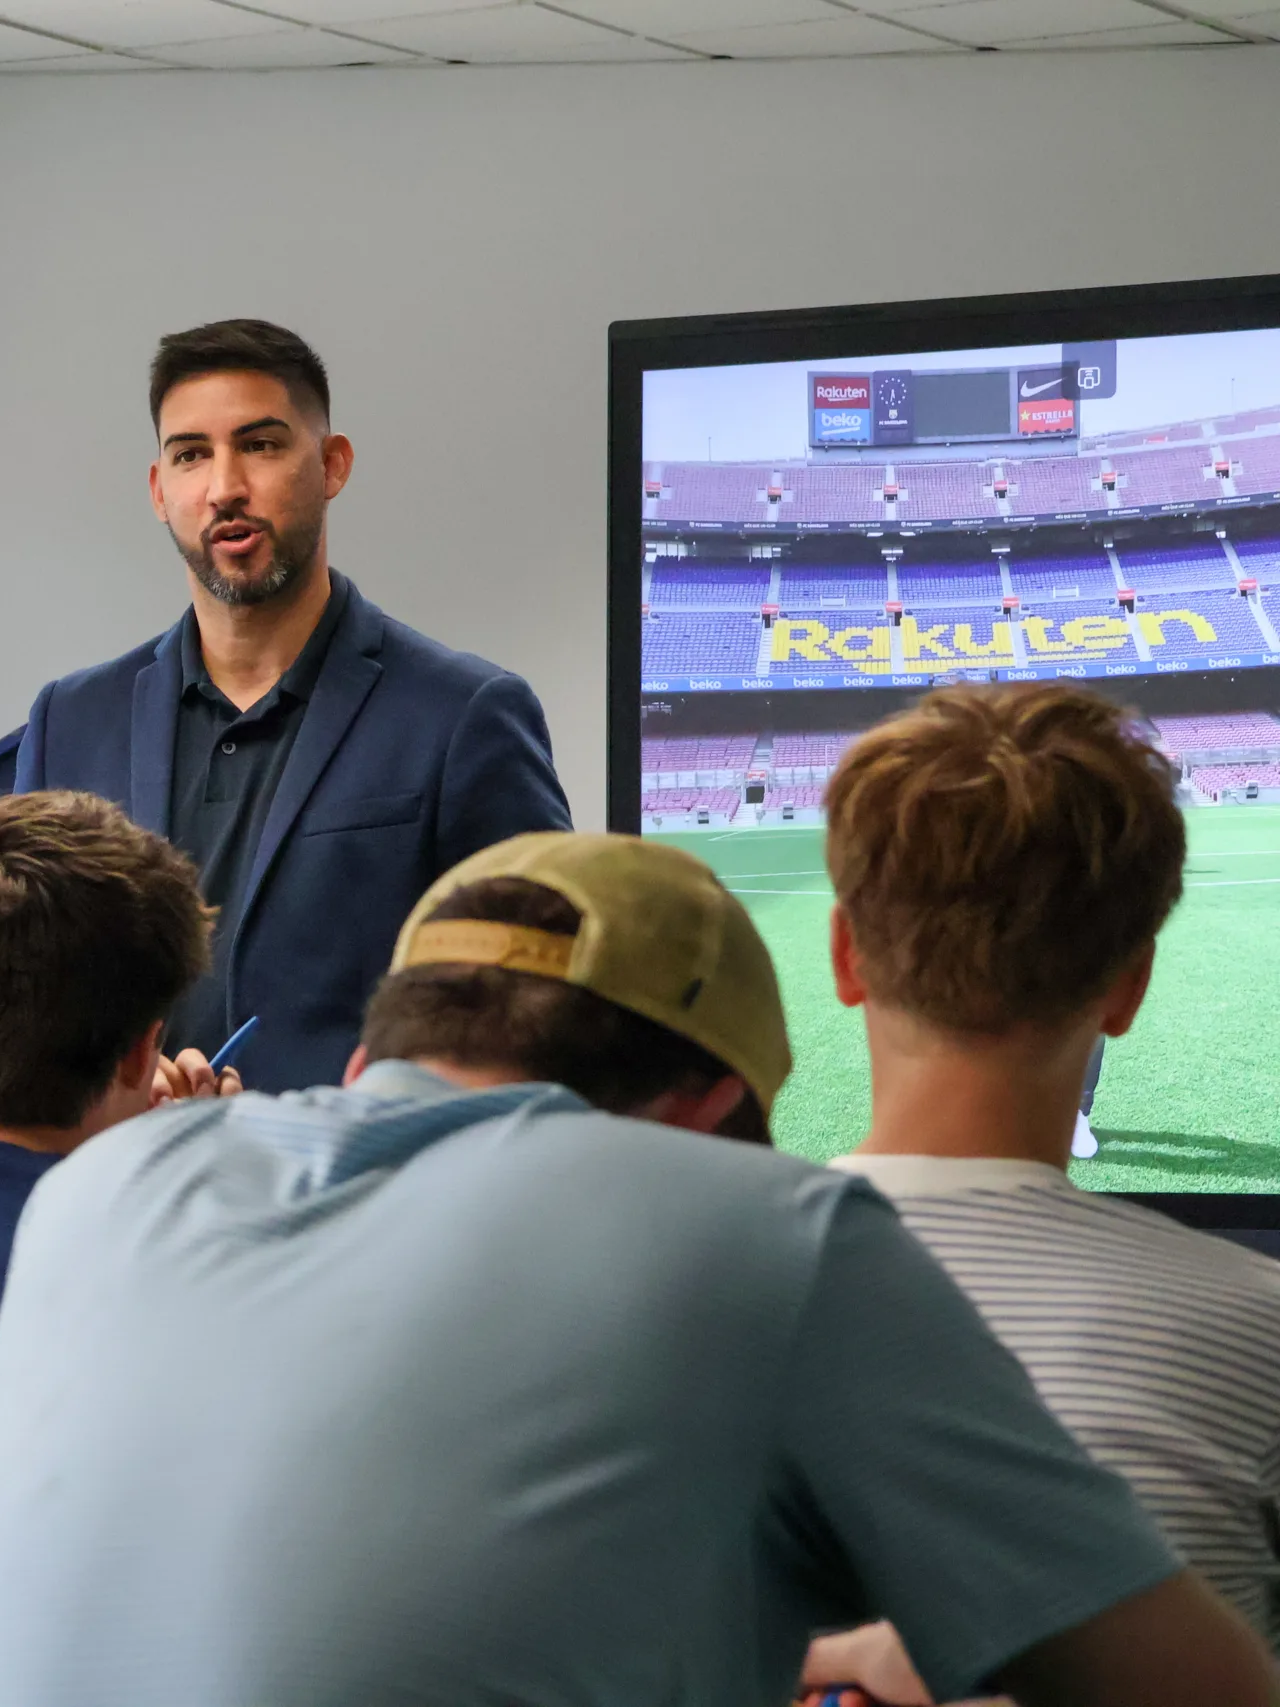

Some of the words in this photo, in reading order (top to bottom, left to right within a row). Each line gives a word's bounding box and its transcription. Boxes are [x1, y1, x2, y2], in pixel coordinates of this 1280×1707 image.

[816, 386, 867, 398] Rakuten
[821, 412, 861, 427] beko
[772, 610, 1217, 661] Rakuten
[1208, 657, 1241, 668] beko
[1262, 654, 1280, 664] be
[1056, 666, 1086, 677] beko
[1105, 664, 1136, 675] beko
[1156, 661, 1188, 672] beko
[891, 675, 922, 686] beko
[1007, 670, 1037, 680] beko
[689, 680, 722, 690] beko
[741, 678, 773, 688] beko
[793, 677, 824, 687] beko
[843, 676, 874, 686] beko
